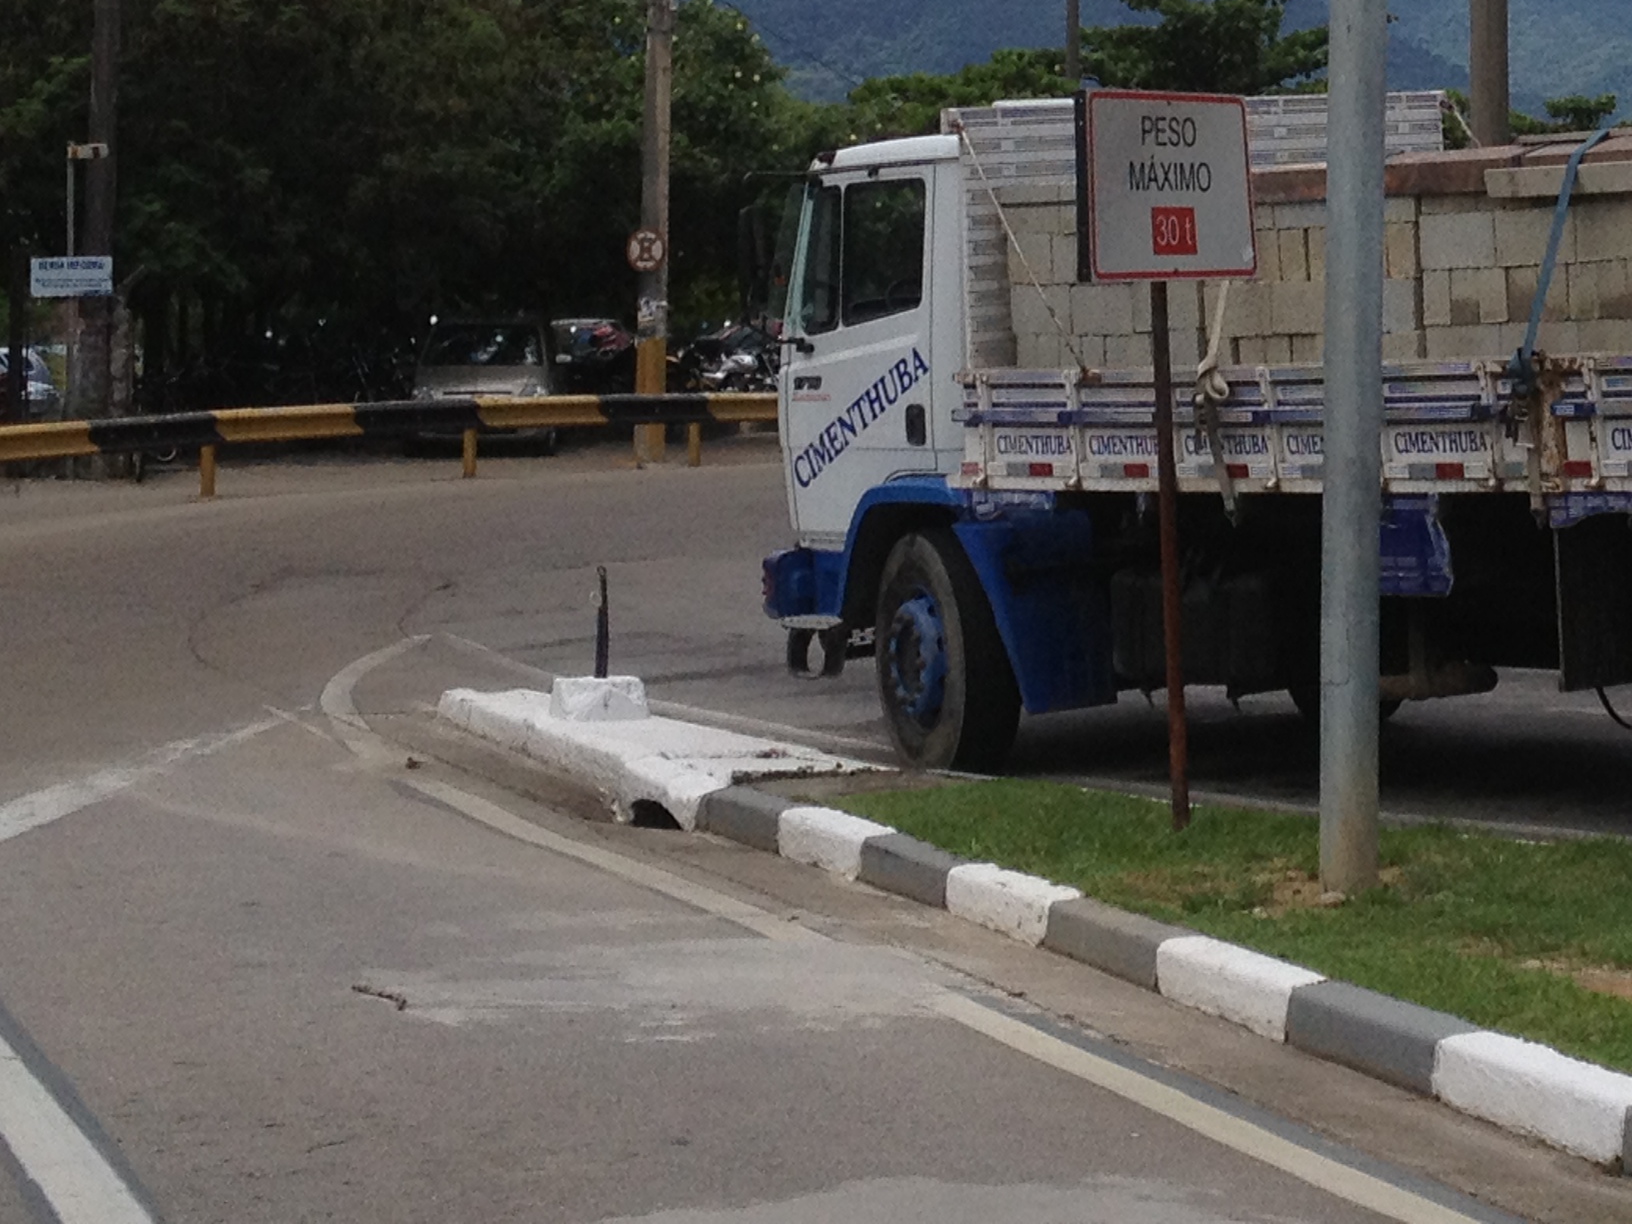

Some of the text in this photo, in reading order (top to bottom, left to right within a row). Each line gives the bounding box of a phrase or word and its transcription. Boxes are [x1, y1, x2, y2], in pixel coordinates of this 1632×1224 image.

[1141, 115, 1197, 147] PESO
[1128, 154, 1212, 193] MÁXIMO
[1155, 214, 1193, 246] 30 t
[794, 346, 930, 488] CIMENTHUBA
[996, 434, 1073, 455] CIMENTHUBA
[1393, 430, 1488, 454] CIMENTHUBA
